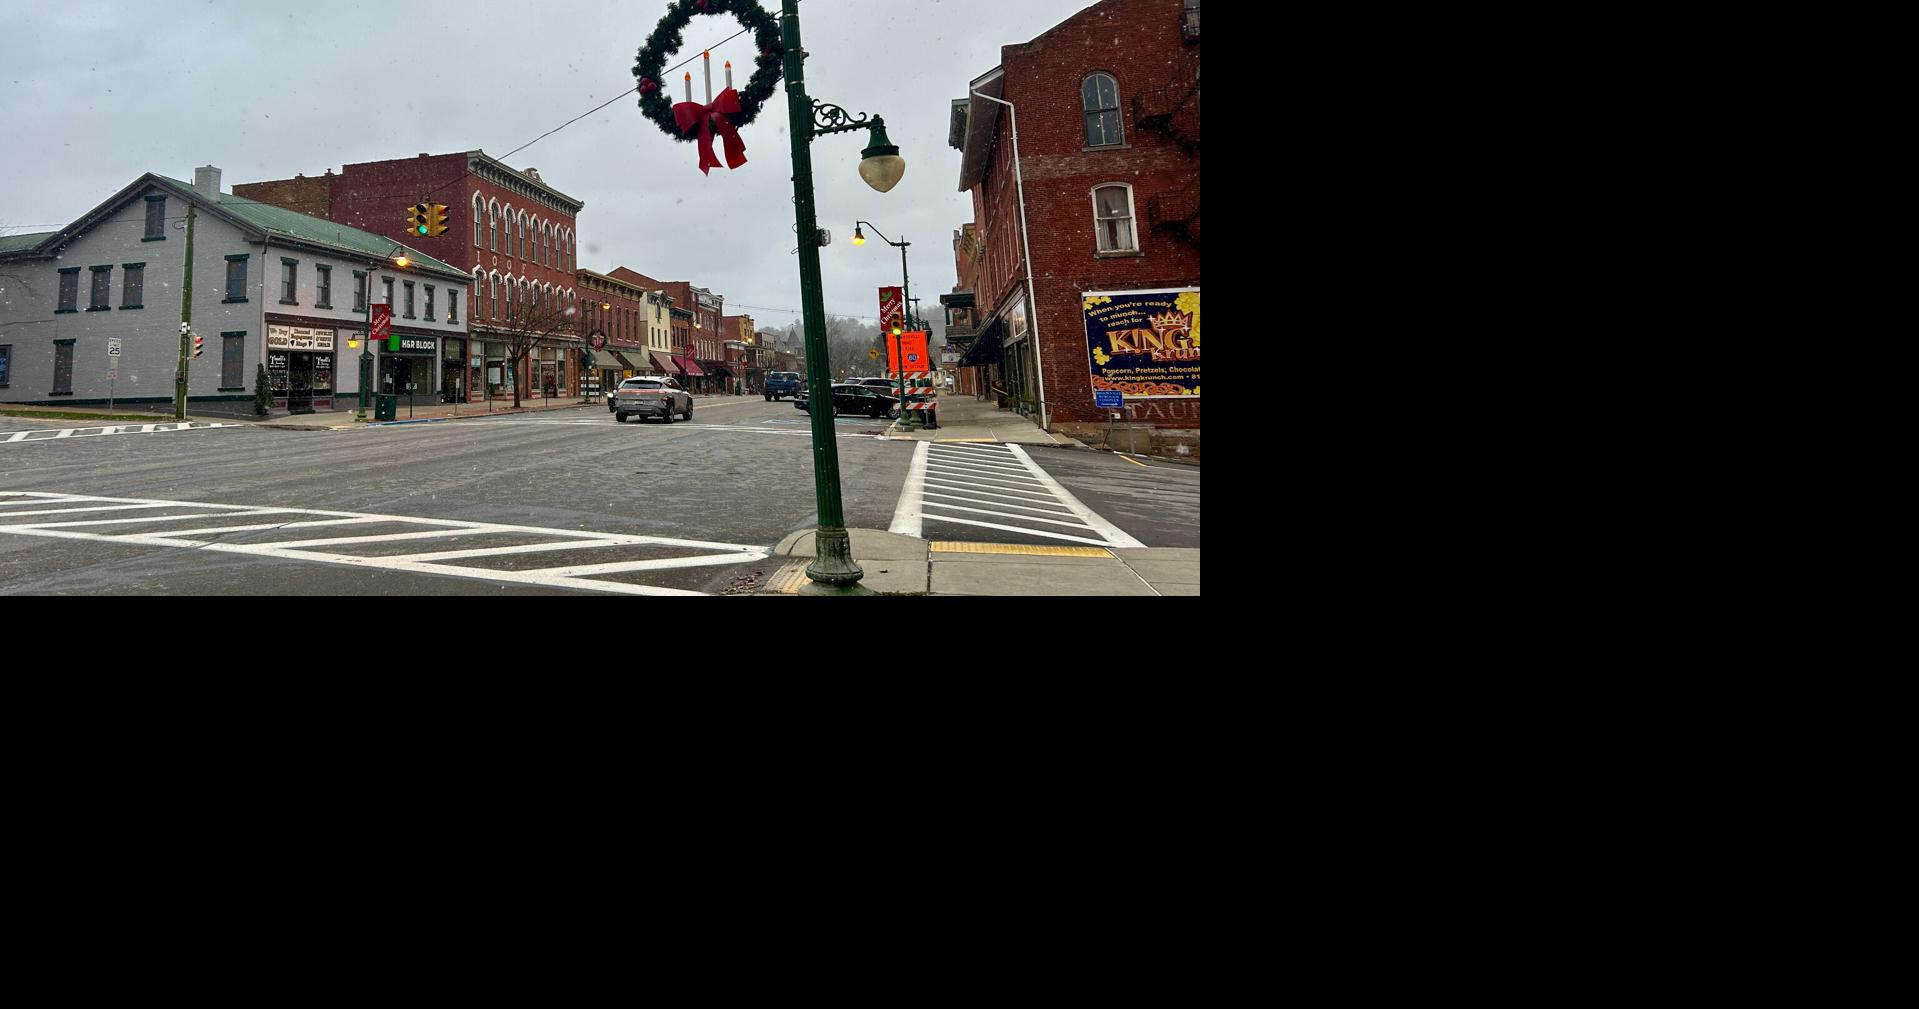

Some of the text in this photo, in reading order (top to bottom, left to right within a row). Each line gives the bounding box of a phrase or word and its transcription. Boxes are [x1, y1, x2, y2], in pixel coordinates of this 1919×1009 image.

[881, 298, 896, 313] Merry
[1088, 300, 1173, 318] When you're ready
[1098, 309, 1146, 324] to munch...
[1107, 317, 1143, 328] reach for
[109, 346, 120, 355] 25
[401, 339, 436, 350] H&R BLOCK
